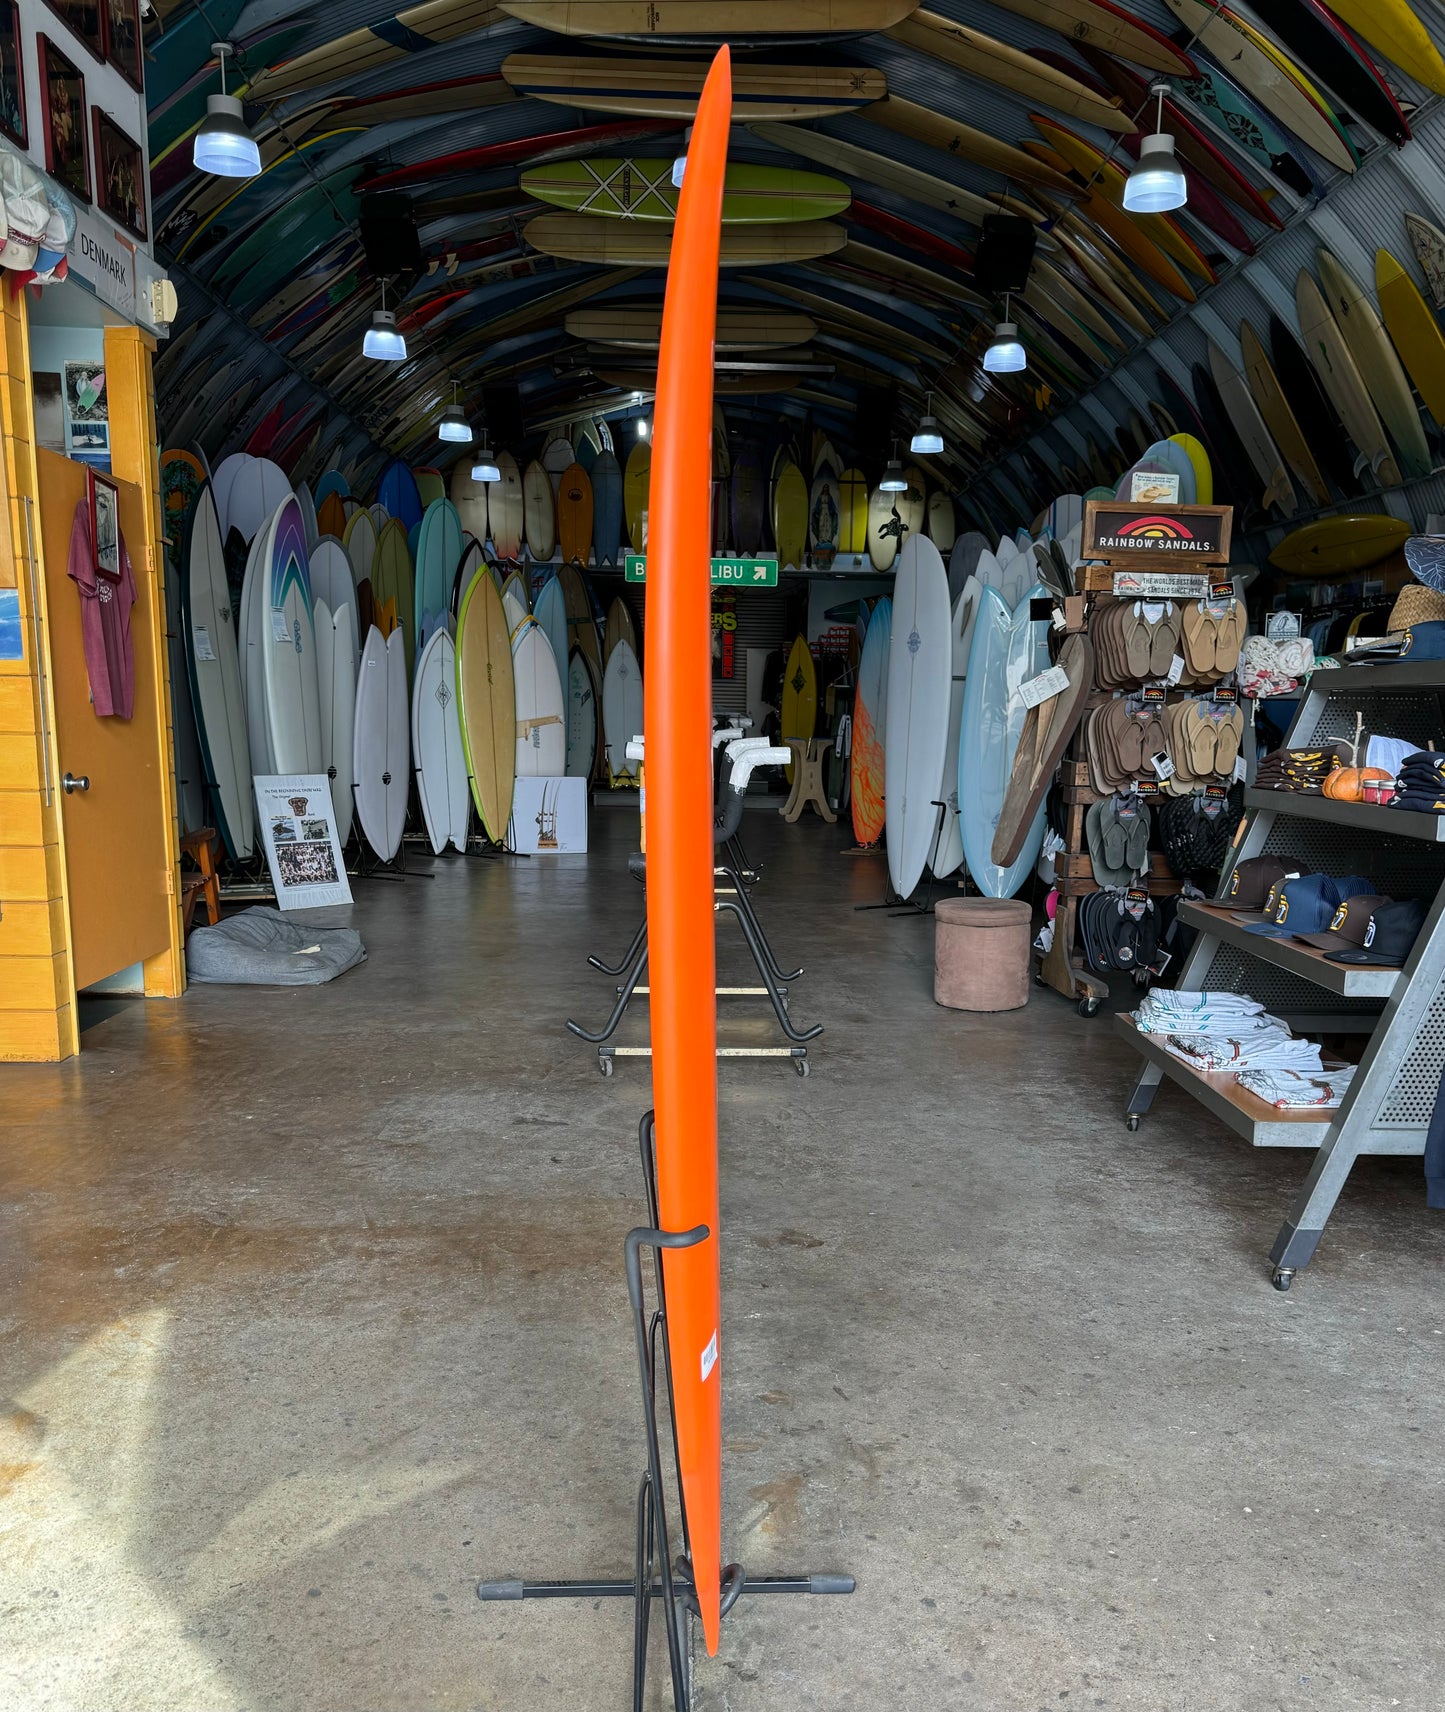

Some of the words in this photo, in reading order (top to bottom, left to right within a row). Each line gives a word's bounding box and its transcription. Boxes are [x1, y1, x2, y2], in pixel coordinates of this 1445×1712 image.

[81, 233, 127, 287] DENMARK
[1099, 537, 1153, 548] RAINBOW
[1158, 539, 1210, 551] SANDALS
[710, 565, 743, 578] LIBU
[1147, 586, 1170, 594] SANDALS
